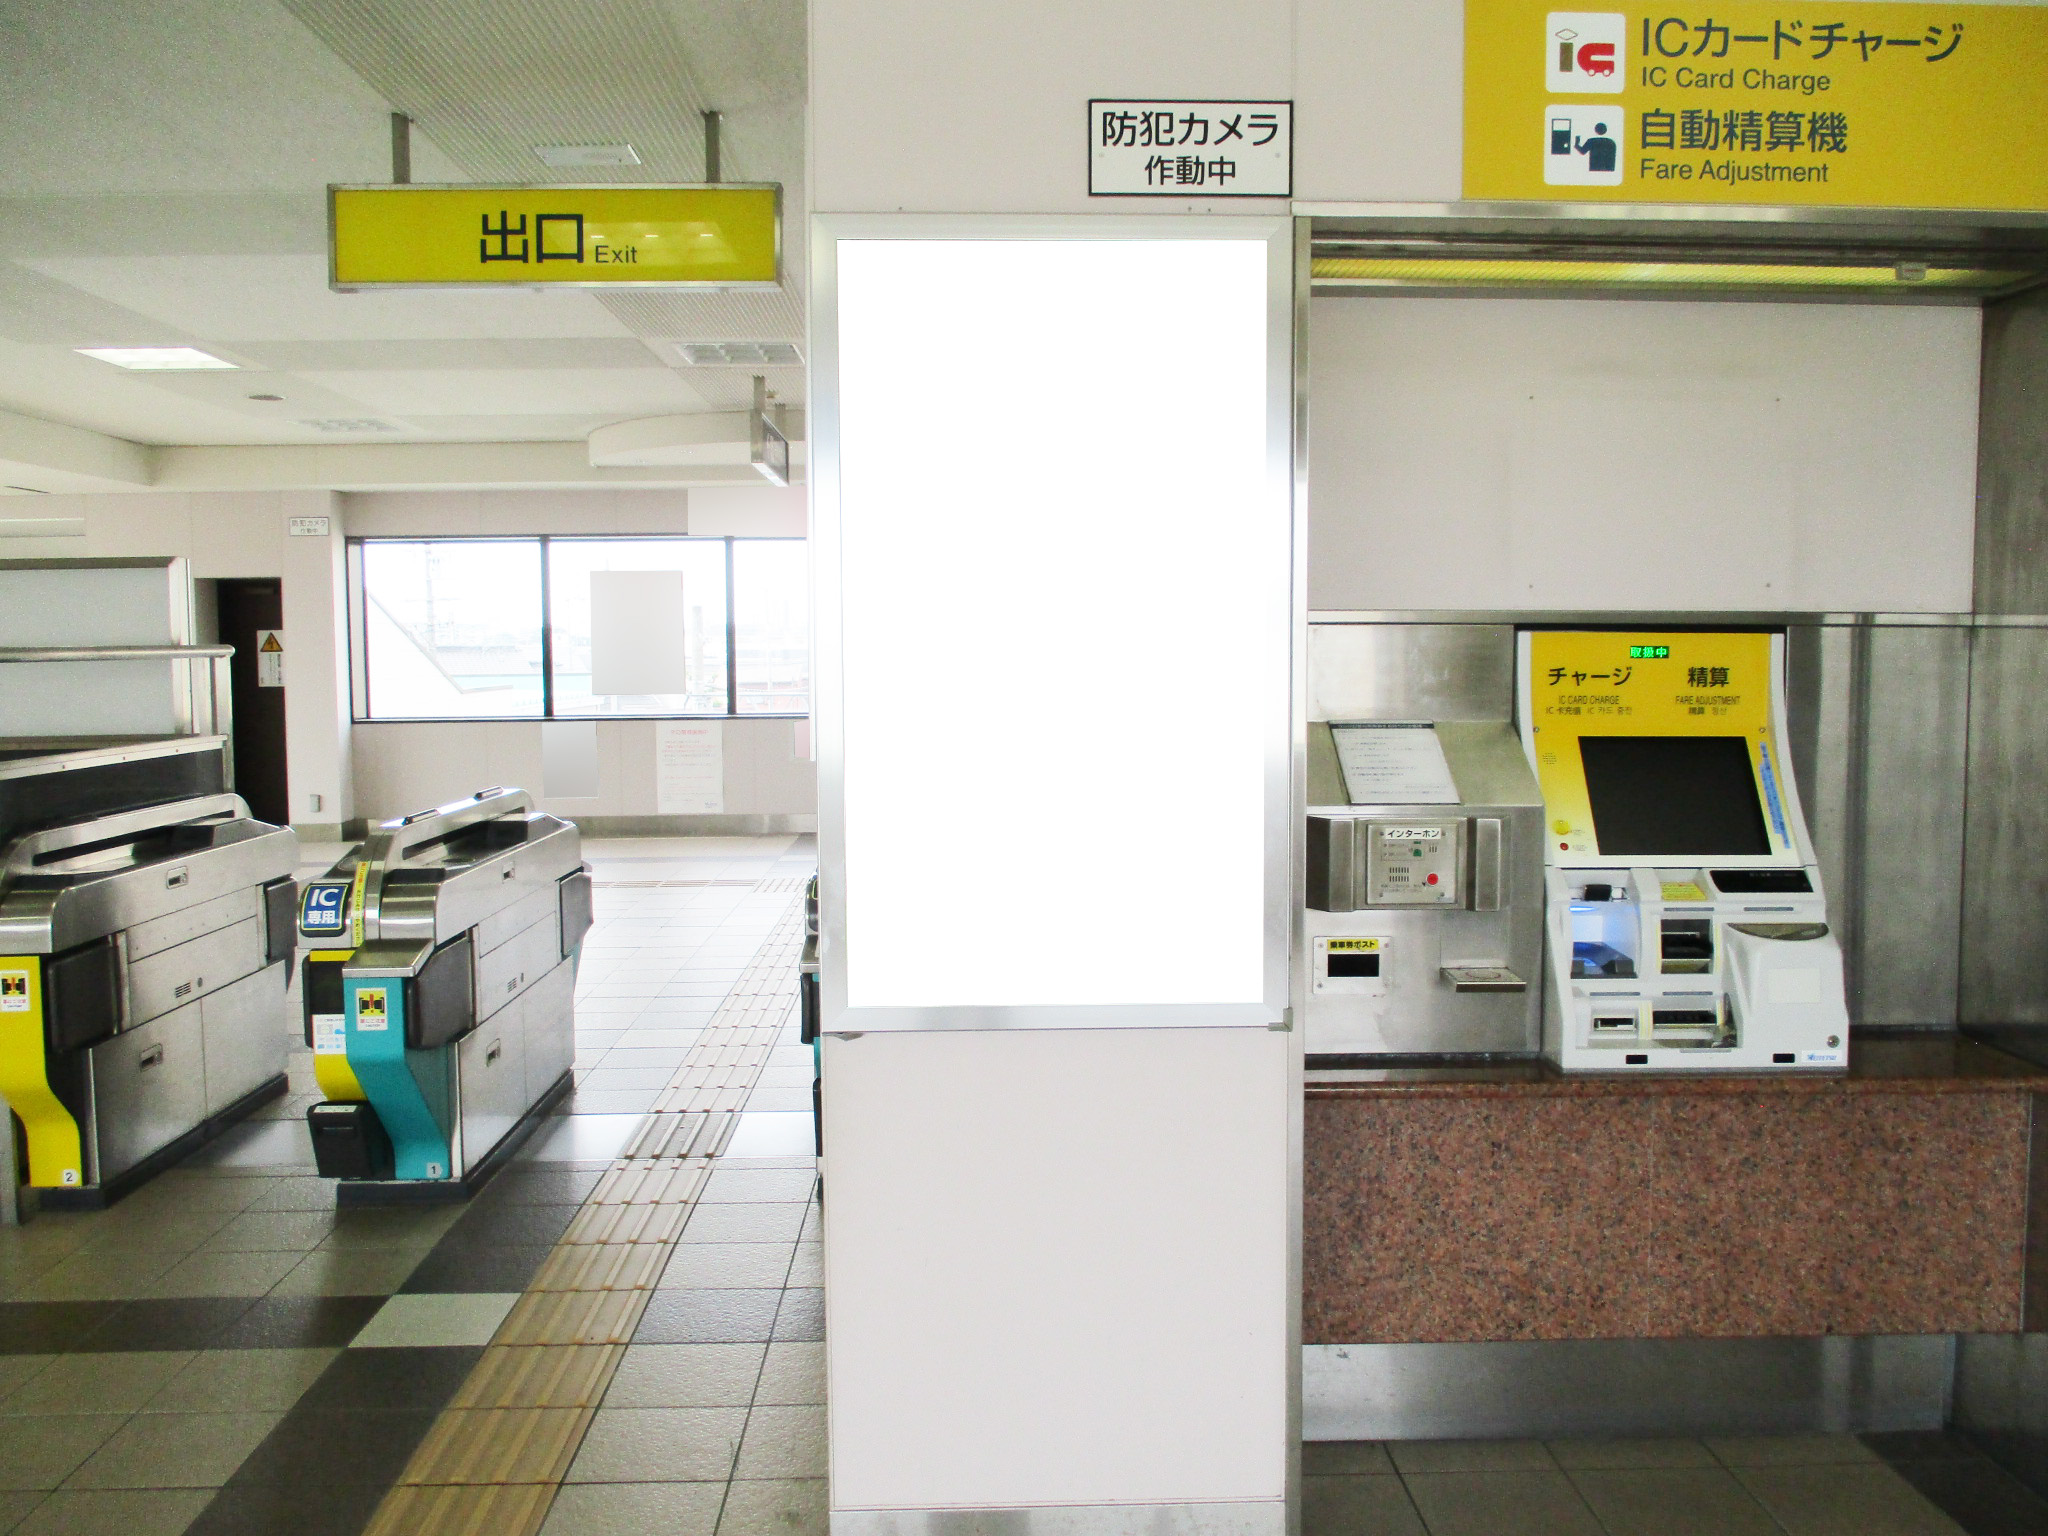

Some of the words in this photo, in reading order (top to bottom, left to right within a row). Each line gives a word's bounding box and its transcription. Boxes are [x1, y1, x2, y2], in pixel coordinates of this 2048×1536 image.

[1642, 17, 1965, 63] ICカードチャージ
[1642, 66, 1667, 87] IC
[1675, 66, 1734, 89] Card
[1742, 67, 1831, 95] Charge
[1102, 110, 1279, 147] 防犯カメラ
[1641, 108, 1849, 154] 自動精算機
[1144, 155, 1236, 186] 作動中
[1640, 158, 1693, 179] Fare
[1698, 159, 1829, 185] Adjustment
[480, 210, 584, 263] 出口
[595, 244, 638, 264] Exit
[1630, 646, 1667, 658] 取扱中
[1548, 666, 1632, 686] チャージ
[1687, 666, 1730, 688] 精算
[1558, 695, 1566, 705] IC
[1567, 695, 1588, 705] CARD
[1589, 695, 1620, 705] CHARGE
[1387, 829, 1440, 838] インターホン
[310, 888, 340, 907] IC
[307, 910, 336, 925] 専用
[65, 1172, 73, 1182] 2
[431, 1165, 437, 1175] 1
